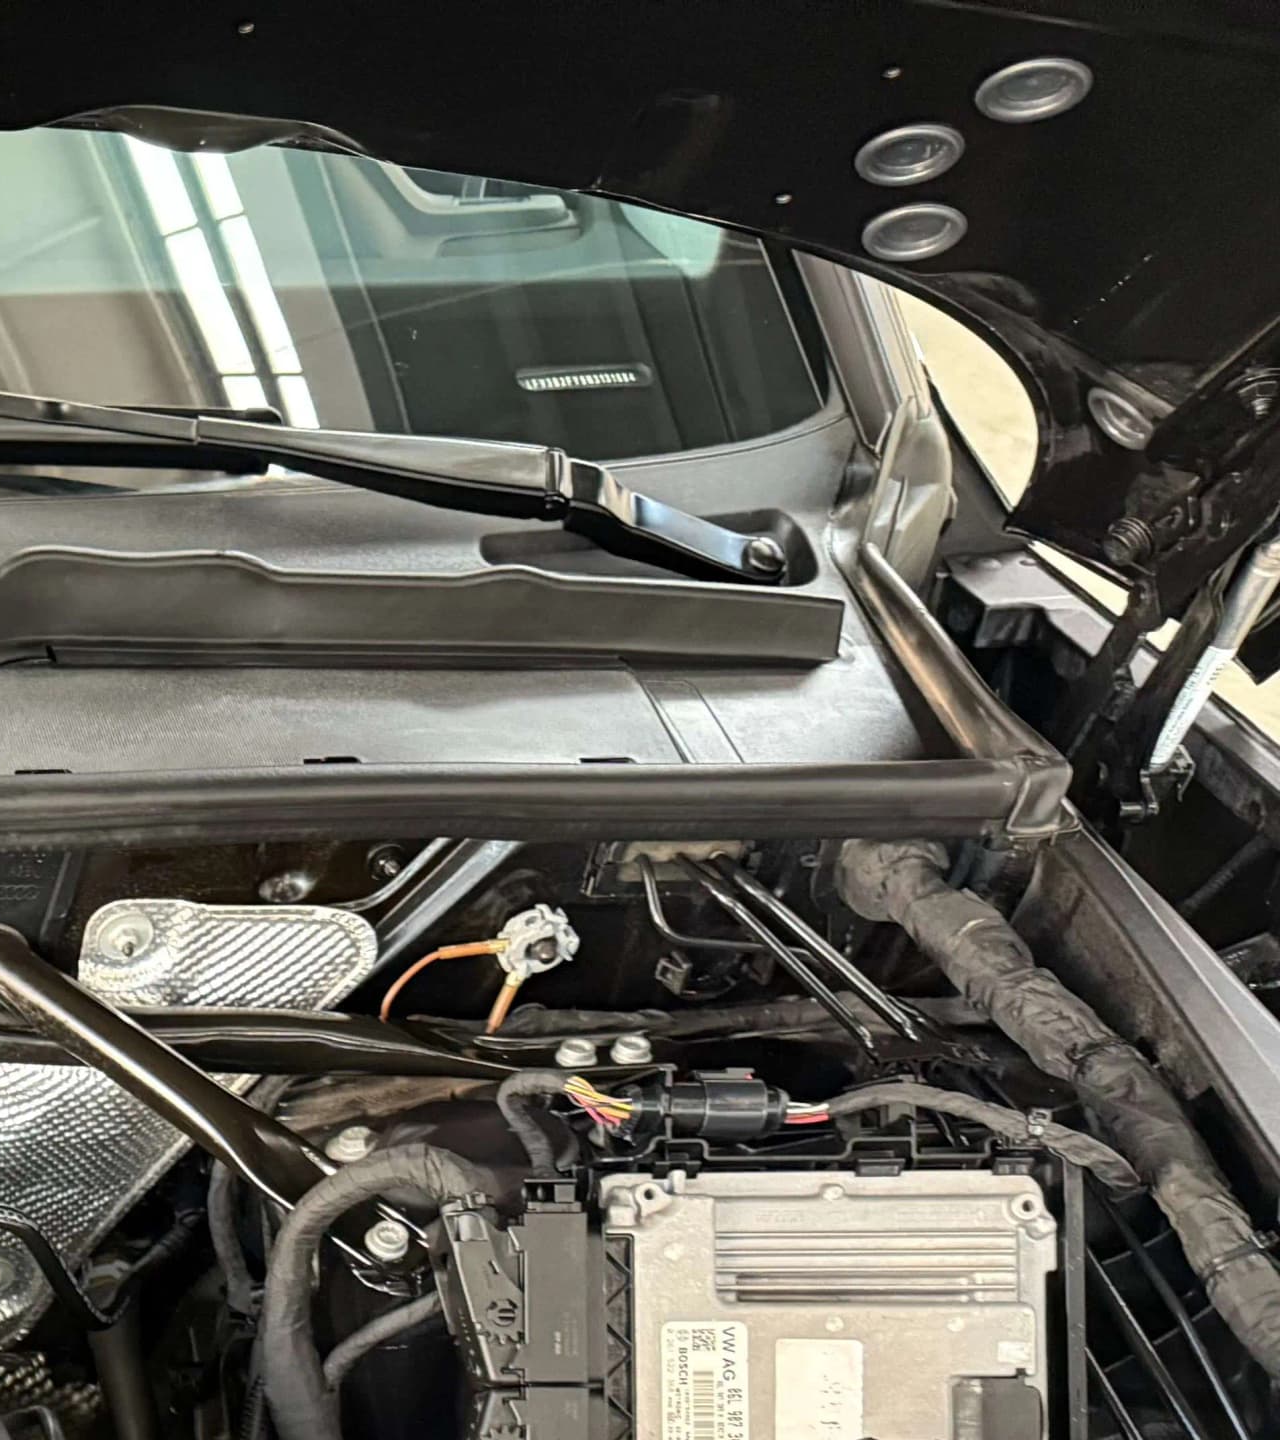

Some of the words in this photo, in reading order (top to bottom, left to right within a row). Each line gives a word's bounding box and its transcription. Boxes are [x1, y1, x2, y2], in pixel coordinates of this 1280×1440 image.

[722, 1326, 735, 1353] VW
[678, 1347, 688, 1385] BOSCH
[722, 1358, 736, 1381] AG
